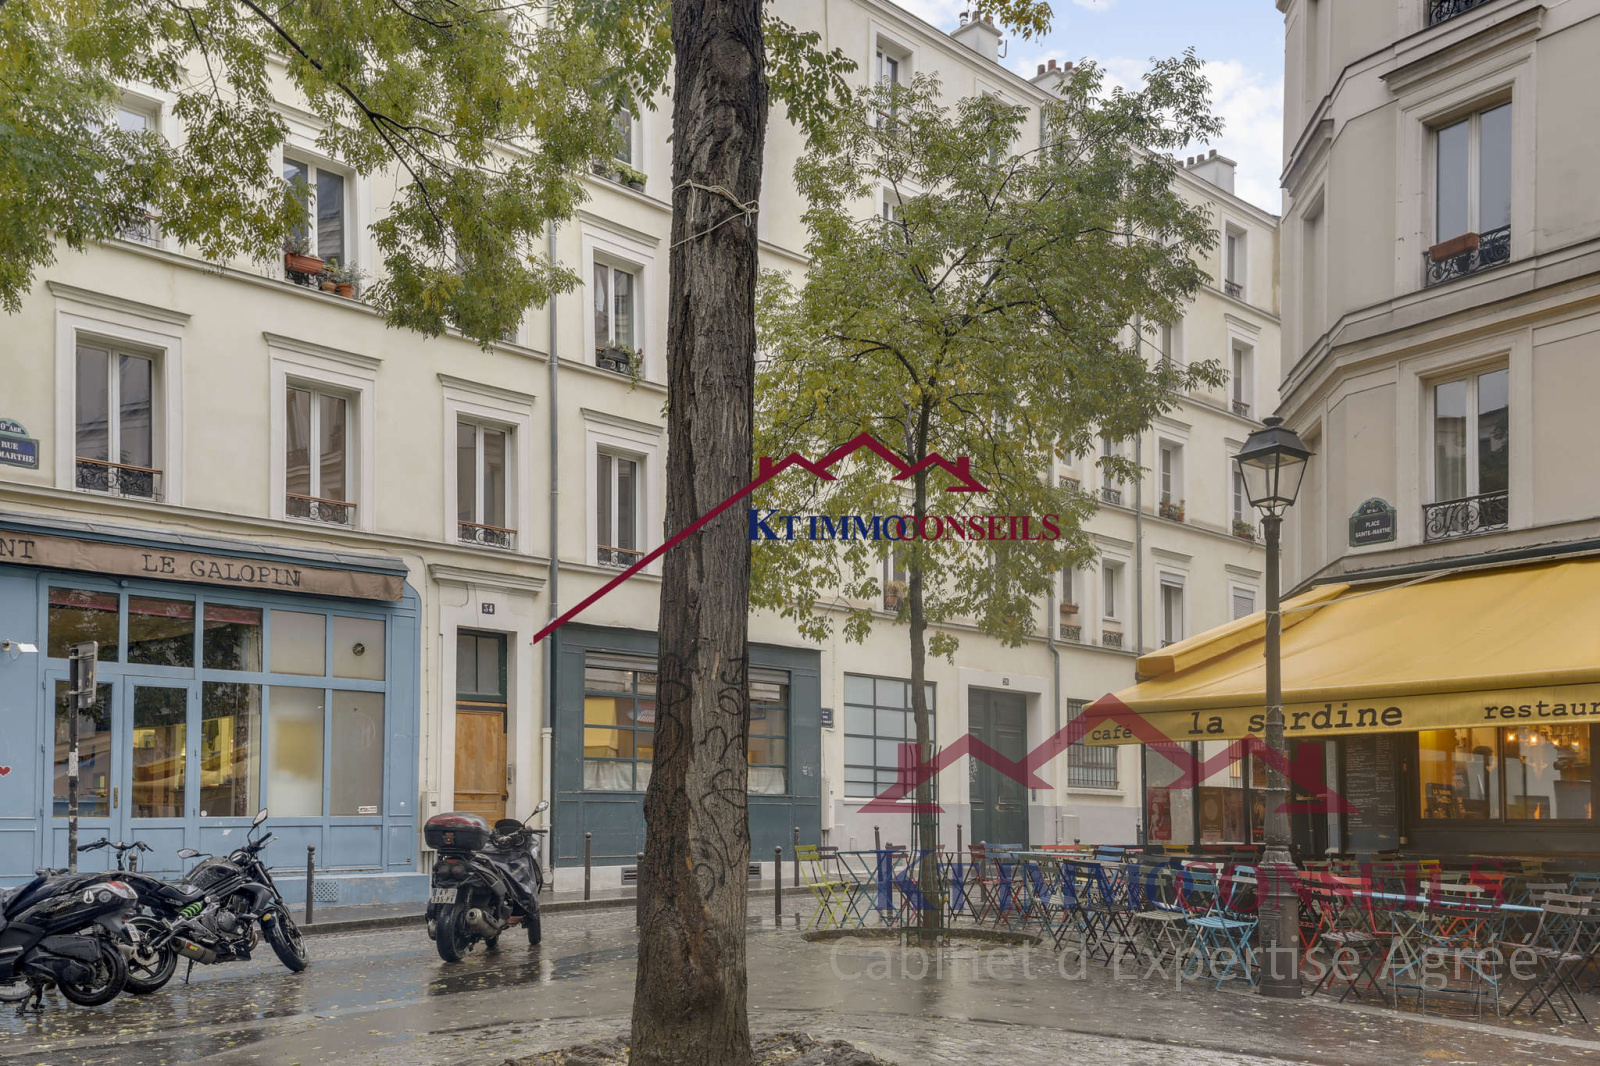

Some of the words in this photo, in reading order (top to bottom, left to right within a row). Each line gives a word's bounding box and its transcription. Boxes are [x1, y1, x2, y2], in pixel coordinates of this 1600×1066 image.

[1, 440, 19, 450] RUE
[1355, 527, 1391, 538] SAINTE-MARTHE
[142, 554, 175, 574] LE
[190, 559, 301, 587] GALOPIN
[1188, 712, 1224, 735] la
[1092, 724, 1132, 741] café
